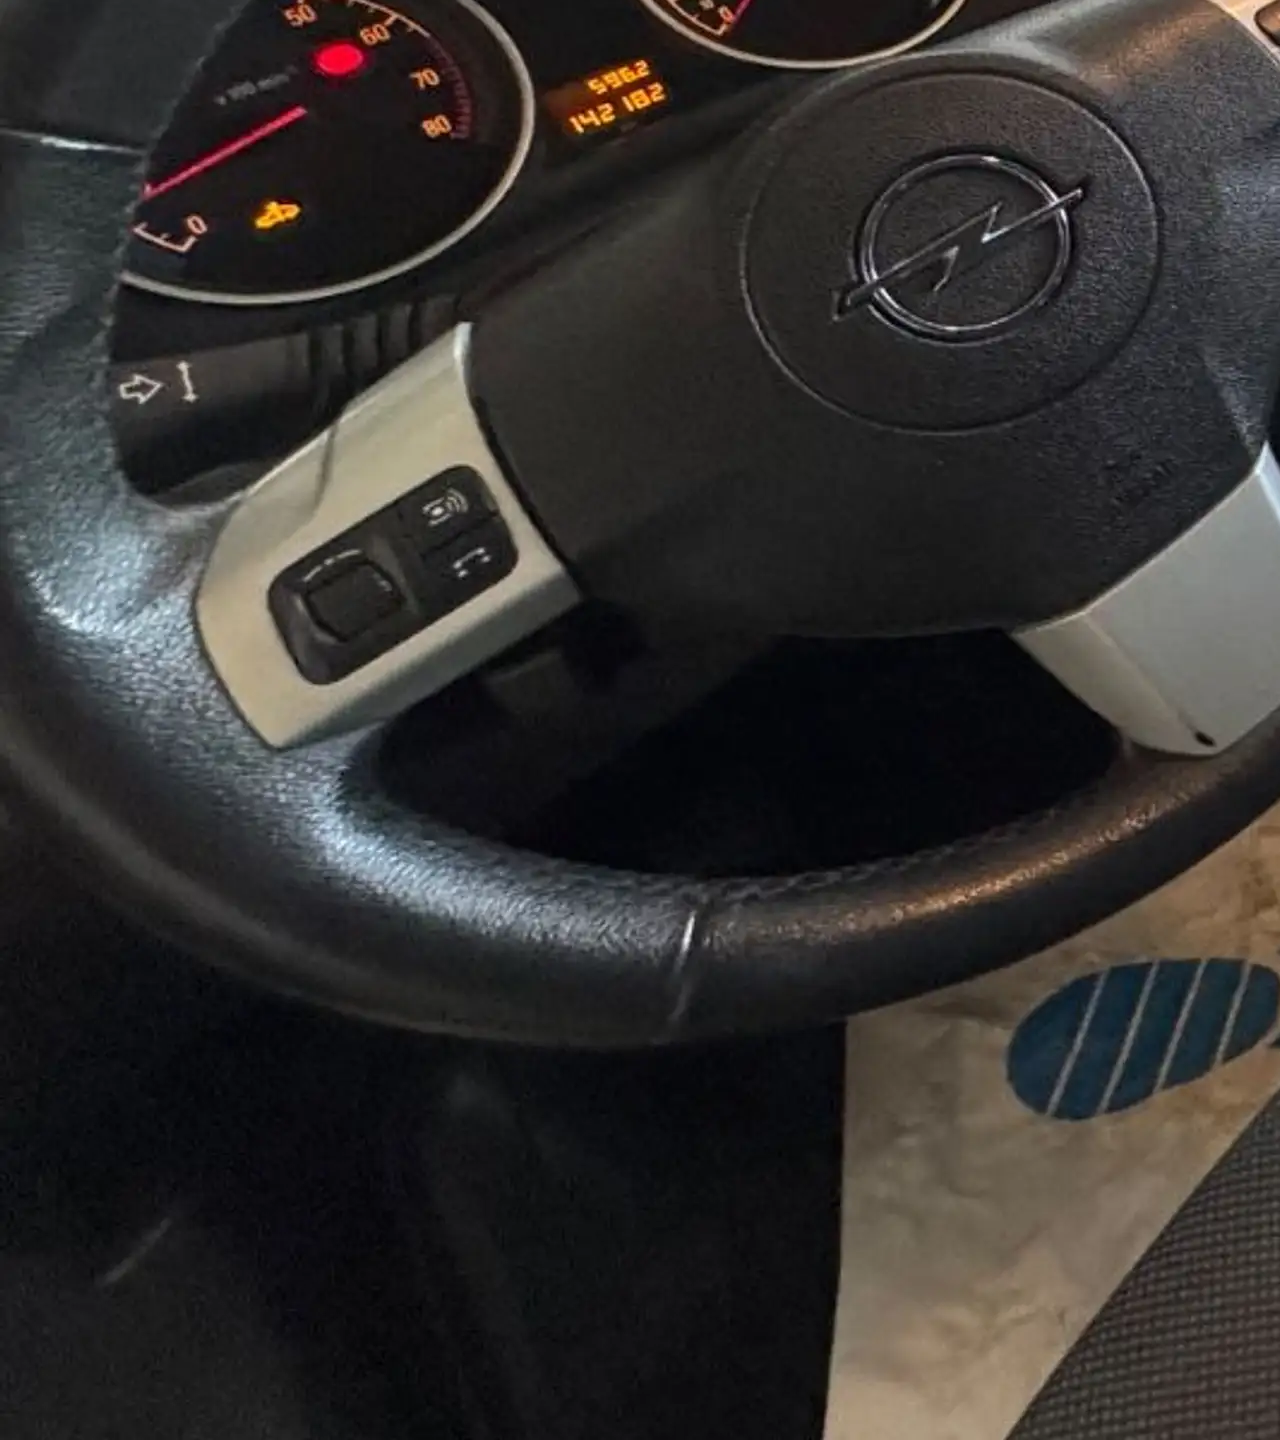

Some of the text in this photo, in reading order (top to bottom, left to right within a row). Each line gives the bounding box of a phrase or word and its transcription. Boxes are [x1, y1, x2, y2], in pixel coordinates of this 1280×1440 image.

[282, 3, 319, 28] 50
[359, 22, 392, 46] 60
[409, 66, 441, 91] 70
[568, 80, 666, 135] 142 182
[421, 113, 453, 139] 80
[185, 215, 209, 236] 0
